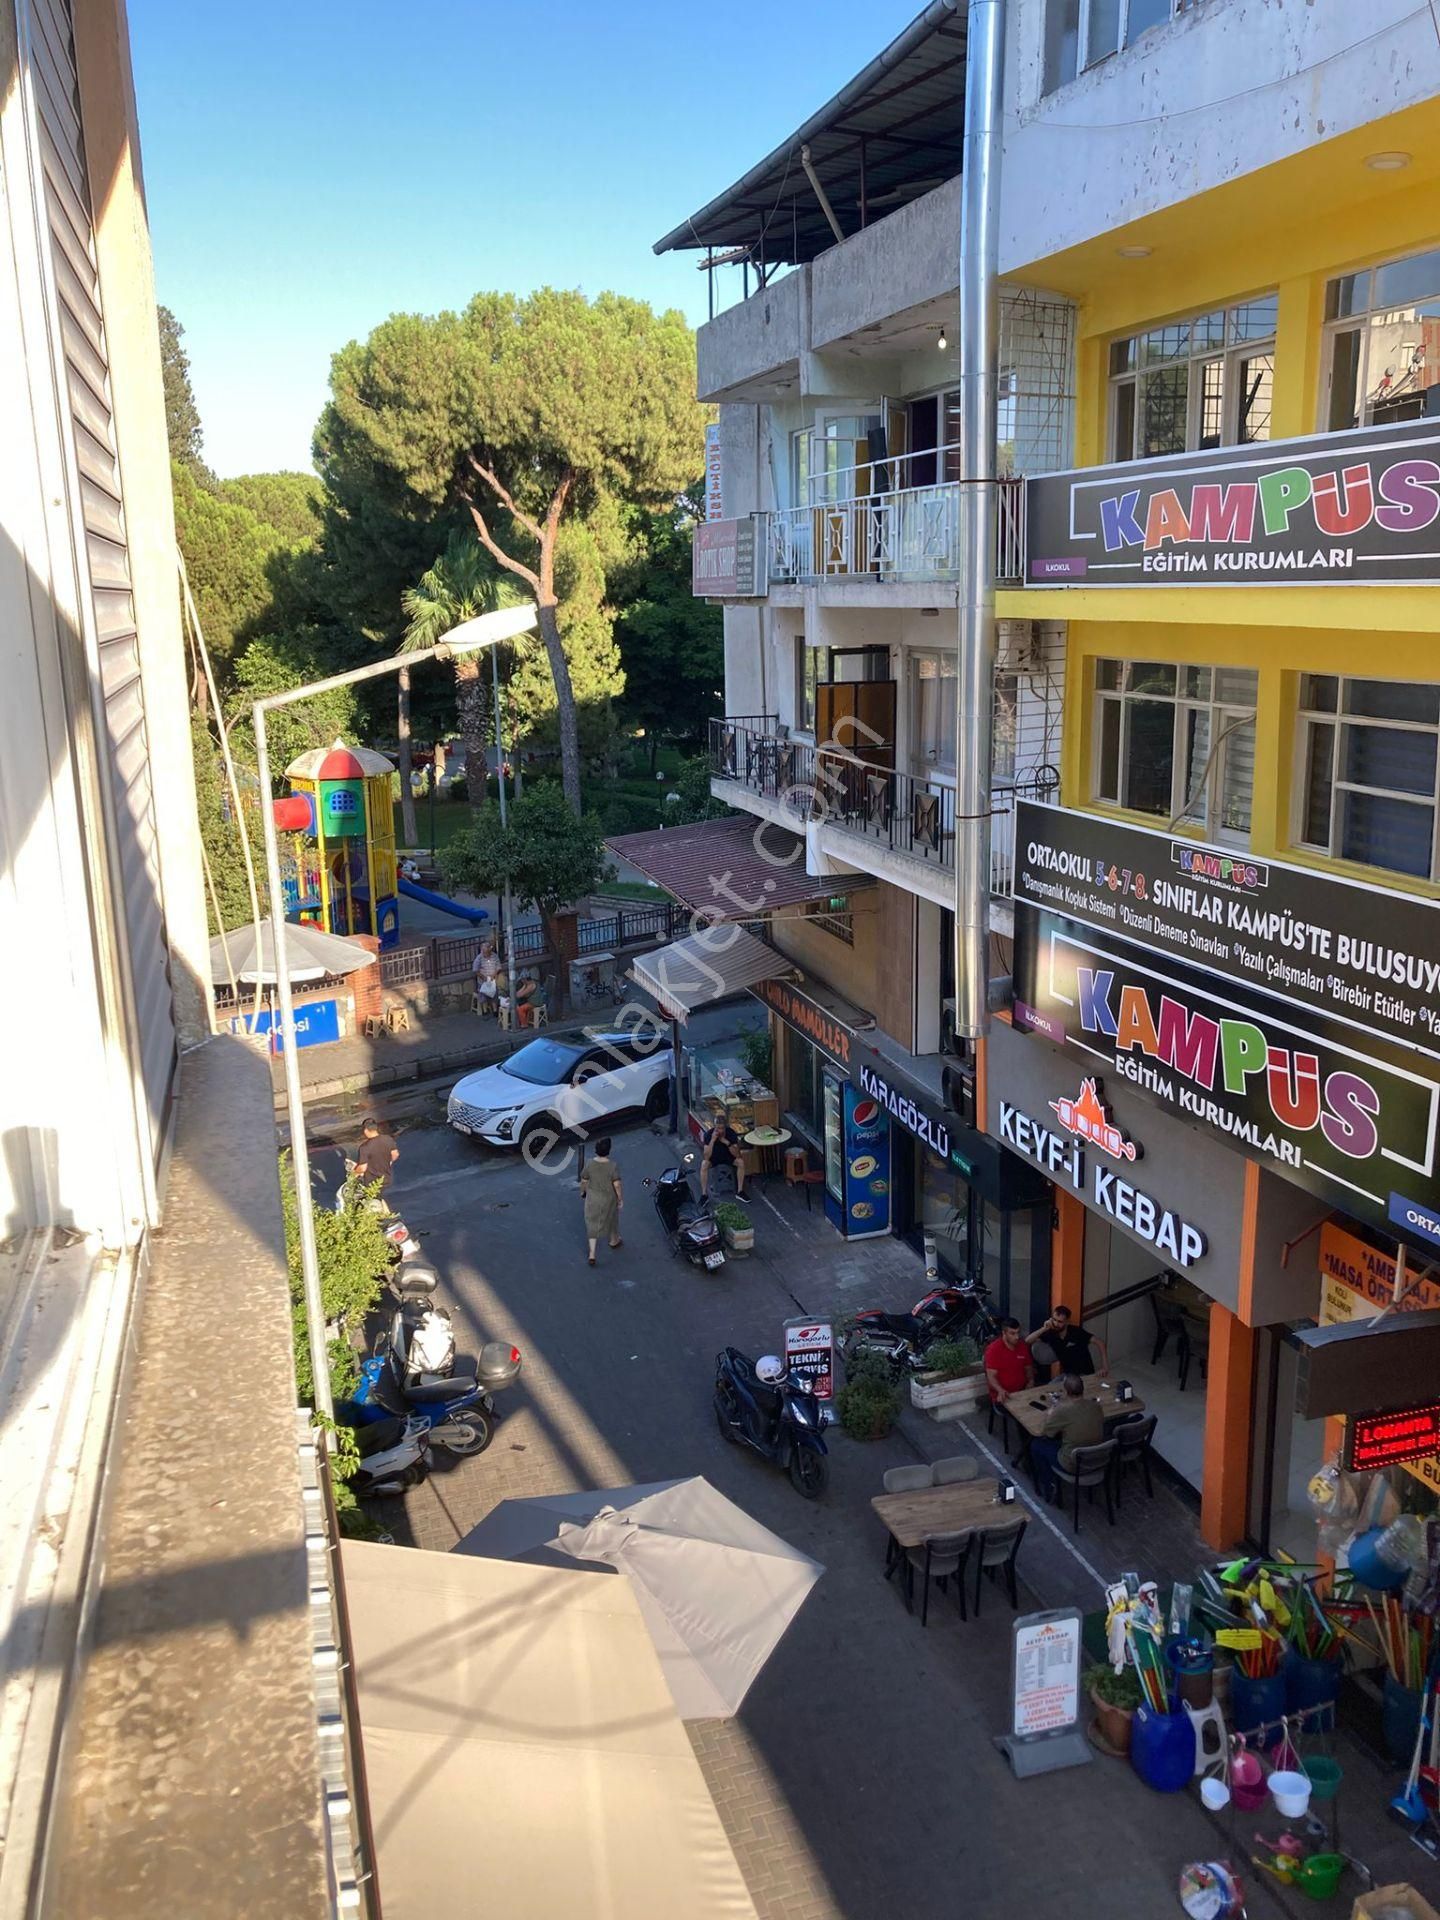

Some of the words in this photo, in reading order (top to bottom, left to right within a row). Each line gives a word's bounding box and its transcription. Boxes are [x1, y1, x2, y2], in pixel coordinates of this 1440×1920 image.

[1100, 460, 1440, 552] KAMPÜS
[1143, 550, 1208, 573] EĞİTİM
[1213, 547, 1354, 571] KURUMLARI
[1027, 841, 1092, 883] ORTAOKUL
[1153, 879, 1223, 925] SINIFLAR
[1227, 901, 1331, 960] KAMPÜS'TE
[1180, 850, 1258, 888] KAMPÜS
[1025, 873, 1064, 901] Danışmanlık
[1064, 886, 1088, 910] Koçluk
[1089, 896, 1116, 920] Sistemi
[1123, 906, 1152, 933] Düzenli
[1153, 916, 1187, 945] Deneme
[1189, 930, 1229, 960] Sınavları
[1239, 944, 1264, 973] Yazılı
[1266, 955, 1325, 994] Çalışmaları
[1332, 976, 1372, 1011] Birebir
[1374, 992, 1417, 1027] Etütler
[860, 1065, 949, 1157] KARAGÖZLÜ
[1076, 966, 1381, 1159] KAMPÜS
[1115, 1055, 1174, 1102] EĞİTİM
[1179, 1090, 1301, 1169] KURUMLARI
[1000, 1101, 1082, 1189] KEYF-İ
[1095, 1165, 1205, 1268] KEBAP
